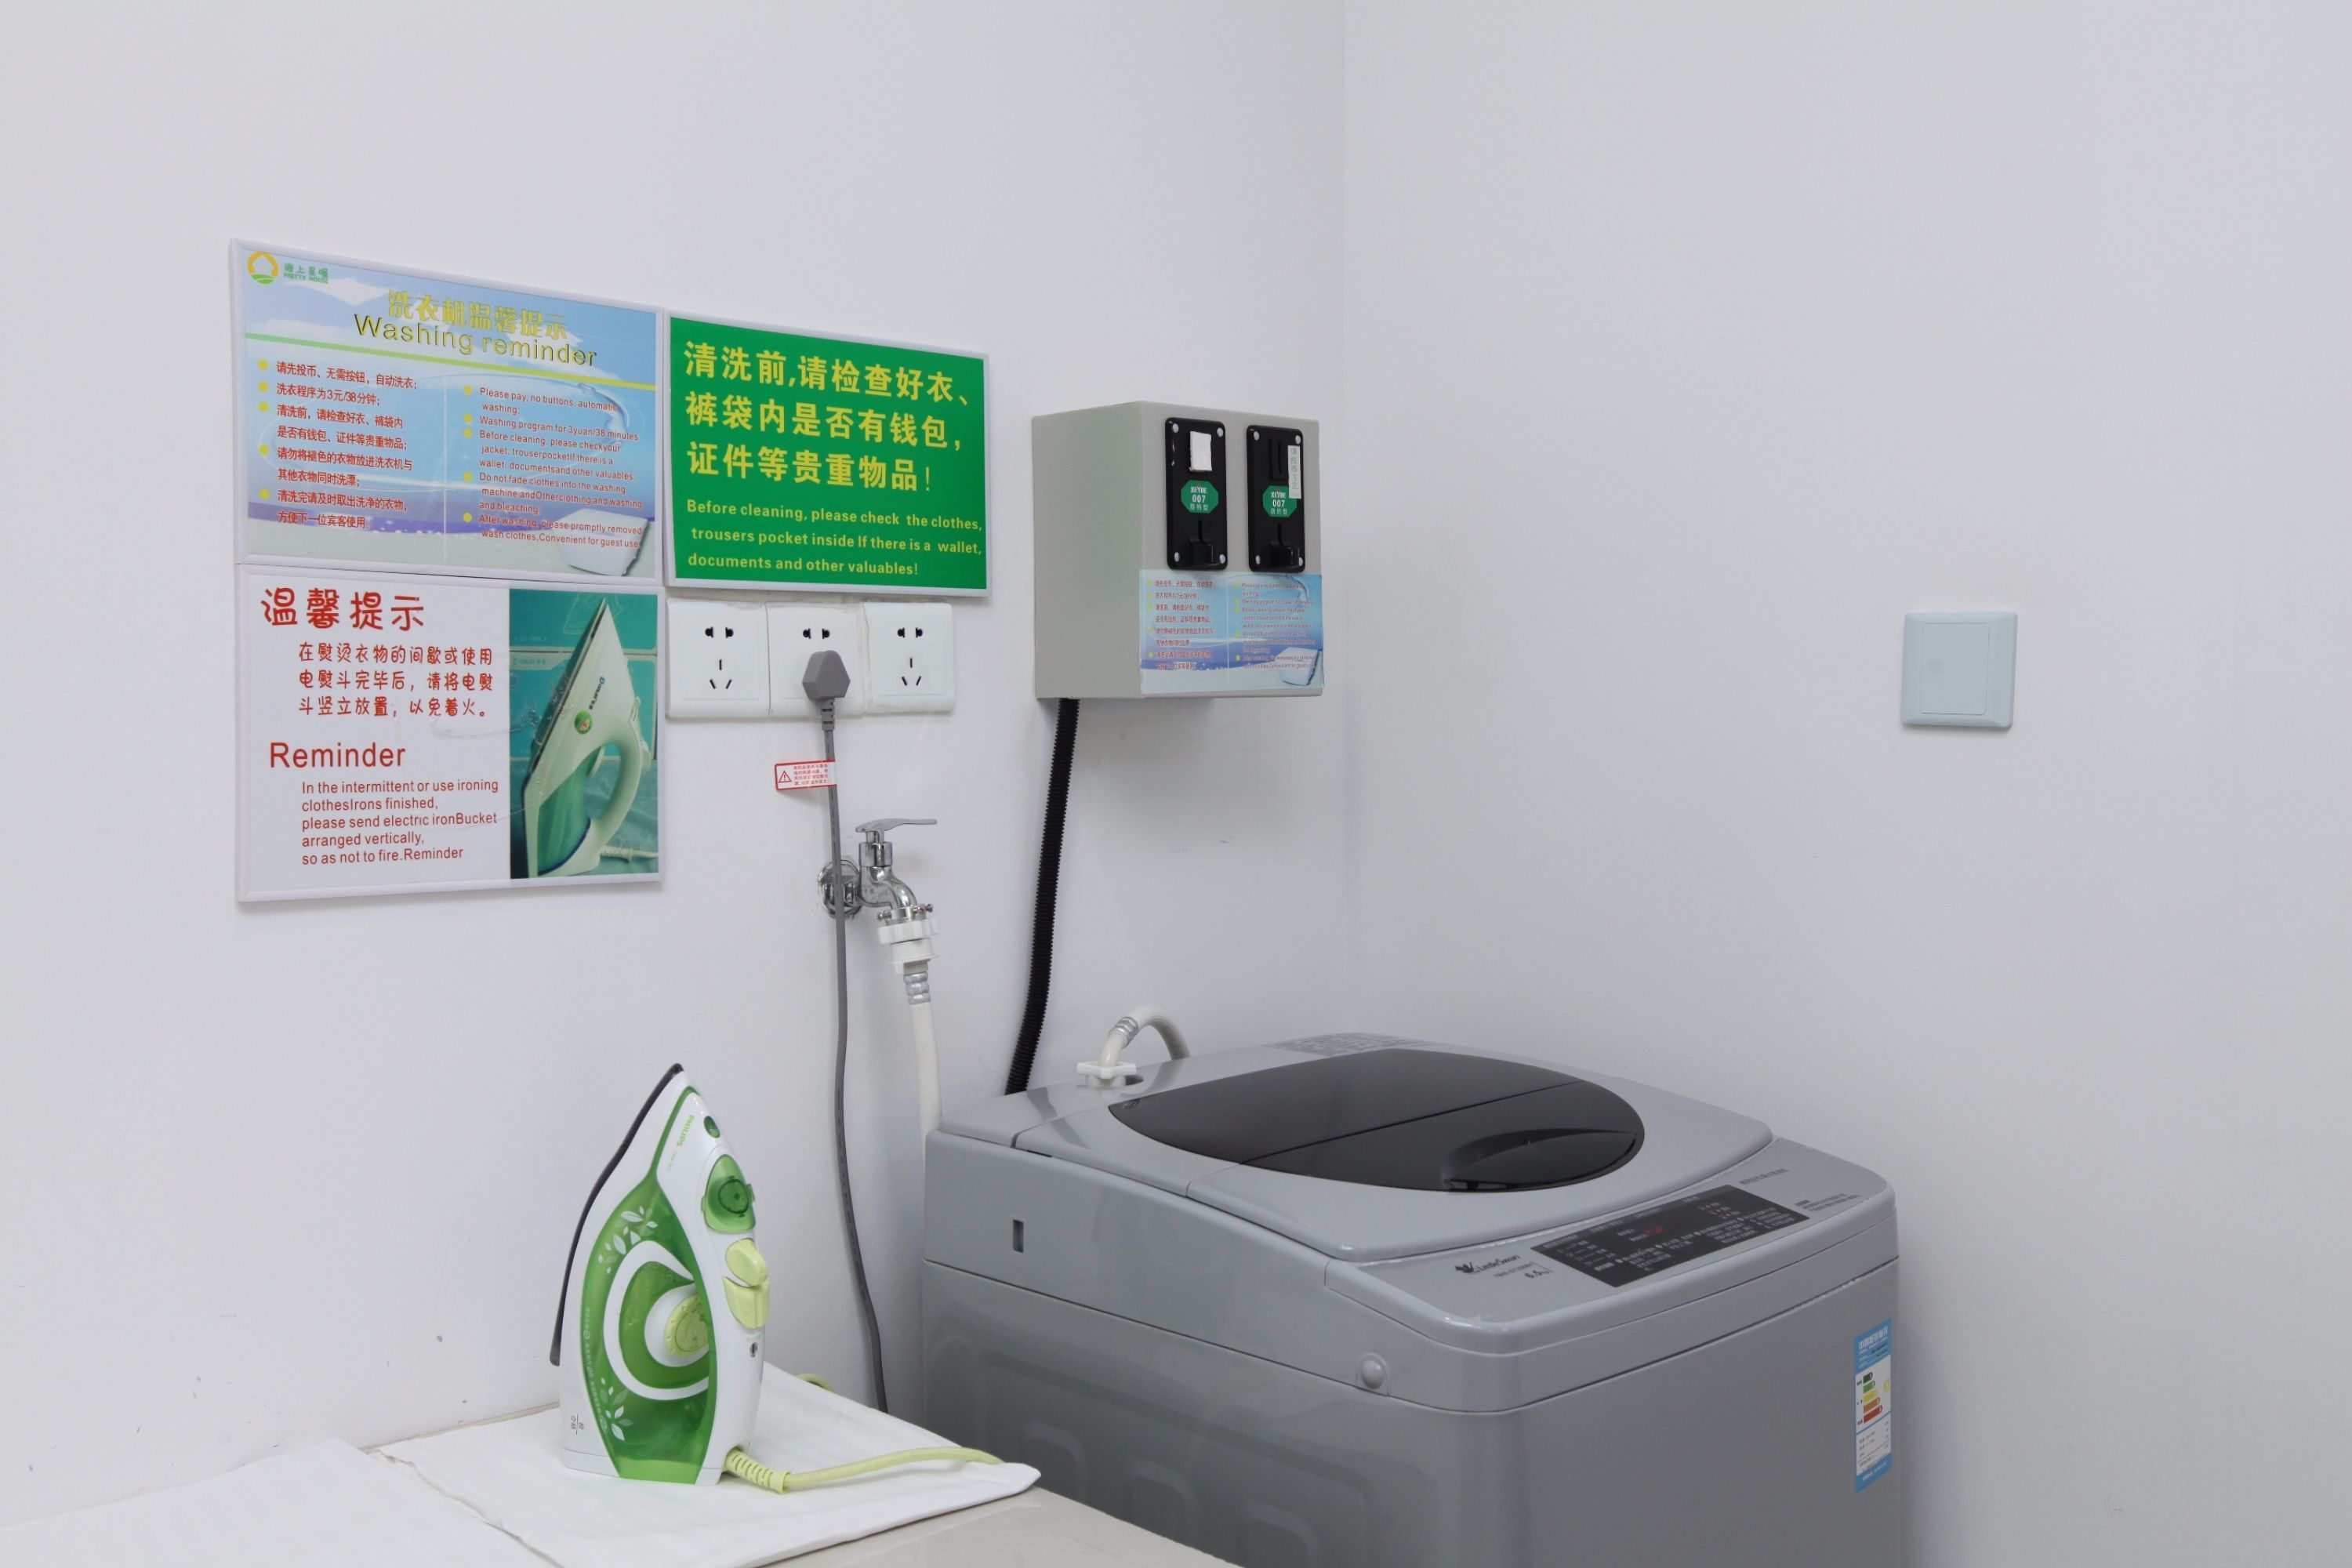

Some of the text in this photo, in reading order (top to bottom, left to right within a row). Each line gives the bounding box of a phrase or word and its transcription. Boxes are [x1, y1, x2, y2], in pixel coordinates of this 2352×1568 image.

[388, 289, 568, 340] 洗衣机温馨提示
[354, 314, 597, 366] Washing reminder
[684, 340, 968, 406] 清洗前,请检查好衣、
[480, 387, 509, 399] Please
[578, 401, 618, 412] automatic
[480, 416, 517, 430] Washing
[518, 422, 554, 433] program
[555, 424, 566, 433] for
[607, 431, 638, 441] minutes
[684, 390, 961, 452] 裤袋内是否有钱包，
[480, 430, 508, 441] Before
[550, 438, 577, 449] please
[510, 462, 570, 475] documentsand
[572, 468, 593, 477] other
[577, 454, 599, 464] there
[687, 441, 931, 492] 证件等贵重物品！
[479, 472, 626, 495] Do not fade clothes into the washing
[479, 501, 495, 510] and
[481, 488, 517, 497] machine
[592, 496, 608, 505] and
[609, 499, 642, 510] washing
[1192, 495, 1206, 503] 007
[1272, 499, 1286, 508] 007
[479, 515, 500, 524] After
[541, 520, 568, 531] please
[571, 522, 606, 534] promptly
[687, 499, 982, 531] Before cleaning, please check the clothes,
[481, 530, 503, 539] wash
[588, 536, 598, 545] for
[601, 539, 622, 548] guest
[691, 528, 982, 555] trousers pocket inside If there is a wallet,
[688, 553, 918, 575] documents and other valuables!
[261, 587, 424, 631] 温馨提示
[299, 642, 492, 666] 在熨烫衣物的间歇或使用
[299, 669, 493, 691] 电熨斗完毕后，请将电熨
[299, 695, 486, 717] 斗竖立放置，以免着火。
[270, 742, 405, 768] Reminder
[302, 779, 499, 793] In the intermittent or use ironing
[385, 797, 438, 810] finished,
[302, 812, 497, 832] please send electric ironBucket
[302, 831, 424, 849] arranged vertically,
[302, 847, 463, 866] so as not to fire.Reminder
